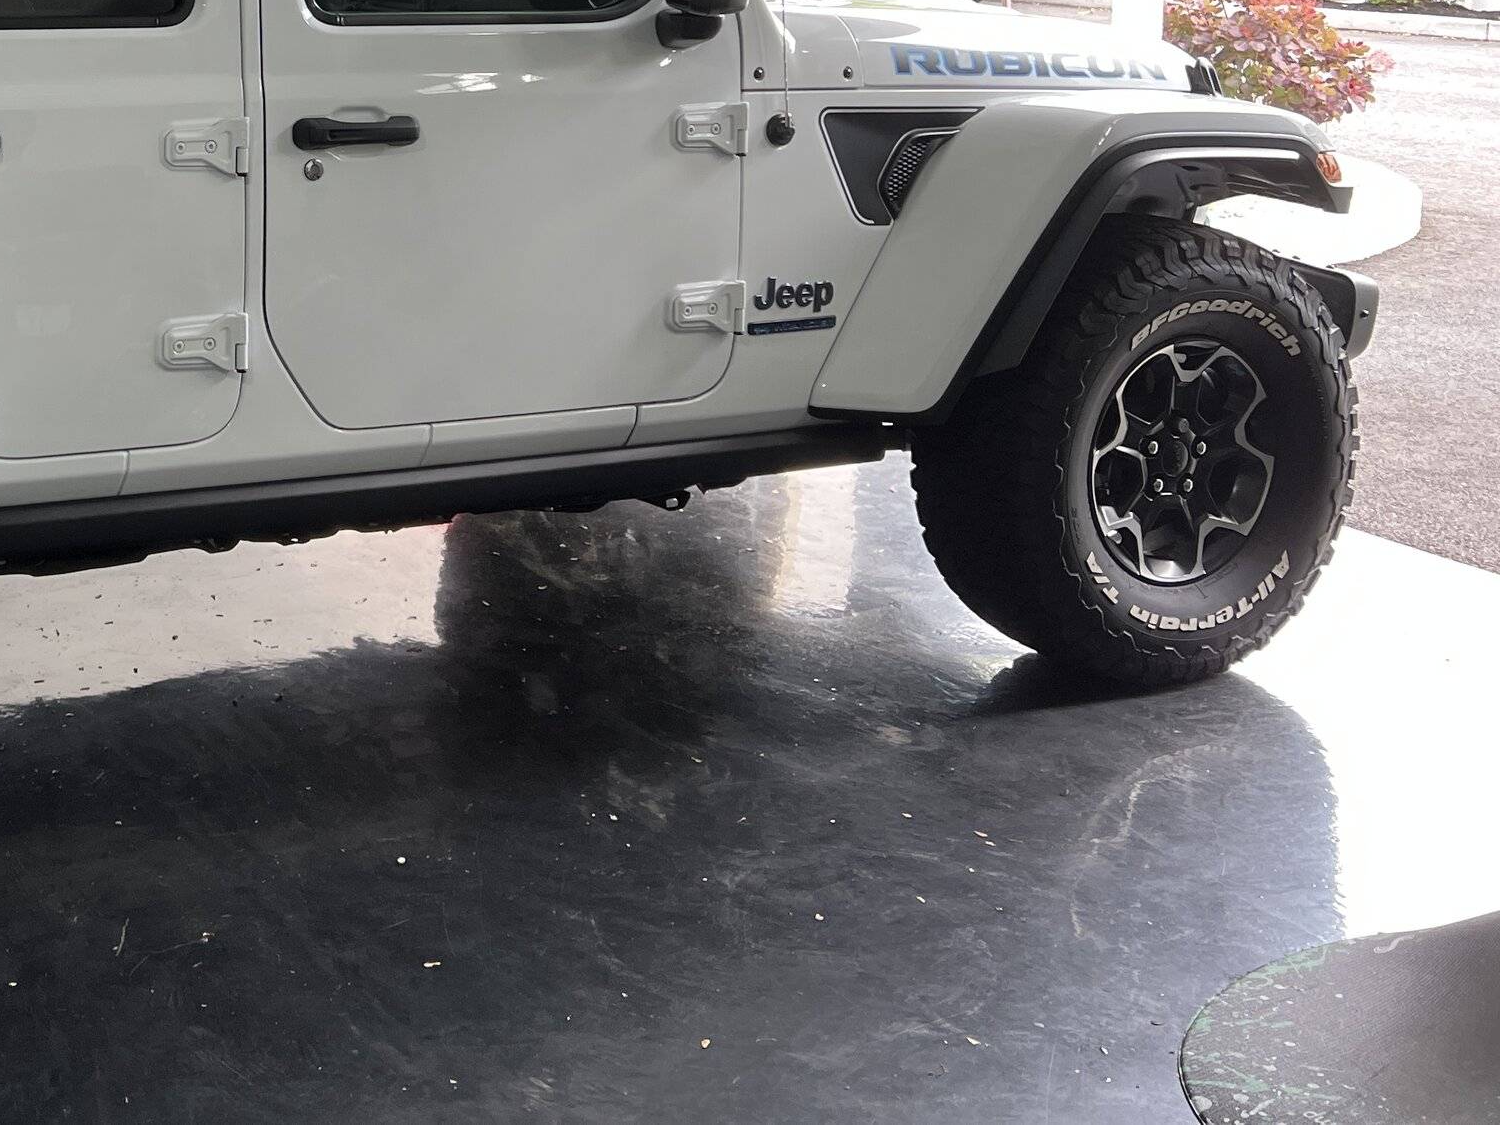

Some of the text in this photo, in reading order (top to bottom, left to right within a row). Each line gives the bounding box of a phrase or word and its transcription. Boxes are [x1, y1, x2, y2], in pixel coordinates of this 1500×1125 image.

[889, 45, 1168, 81] RUBICON
[753, 276, 834, 313] Jeep
[1130, 299, 1301, 357] BFGoodrich
[1086, 549, 1291, 632] All-Terrain T/A
